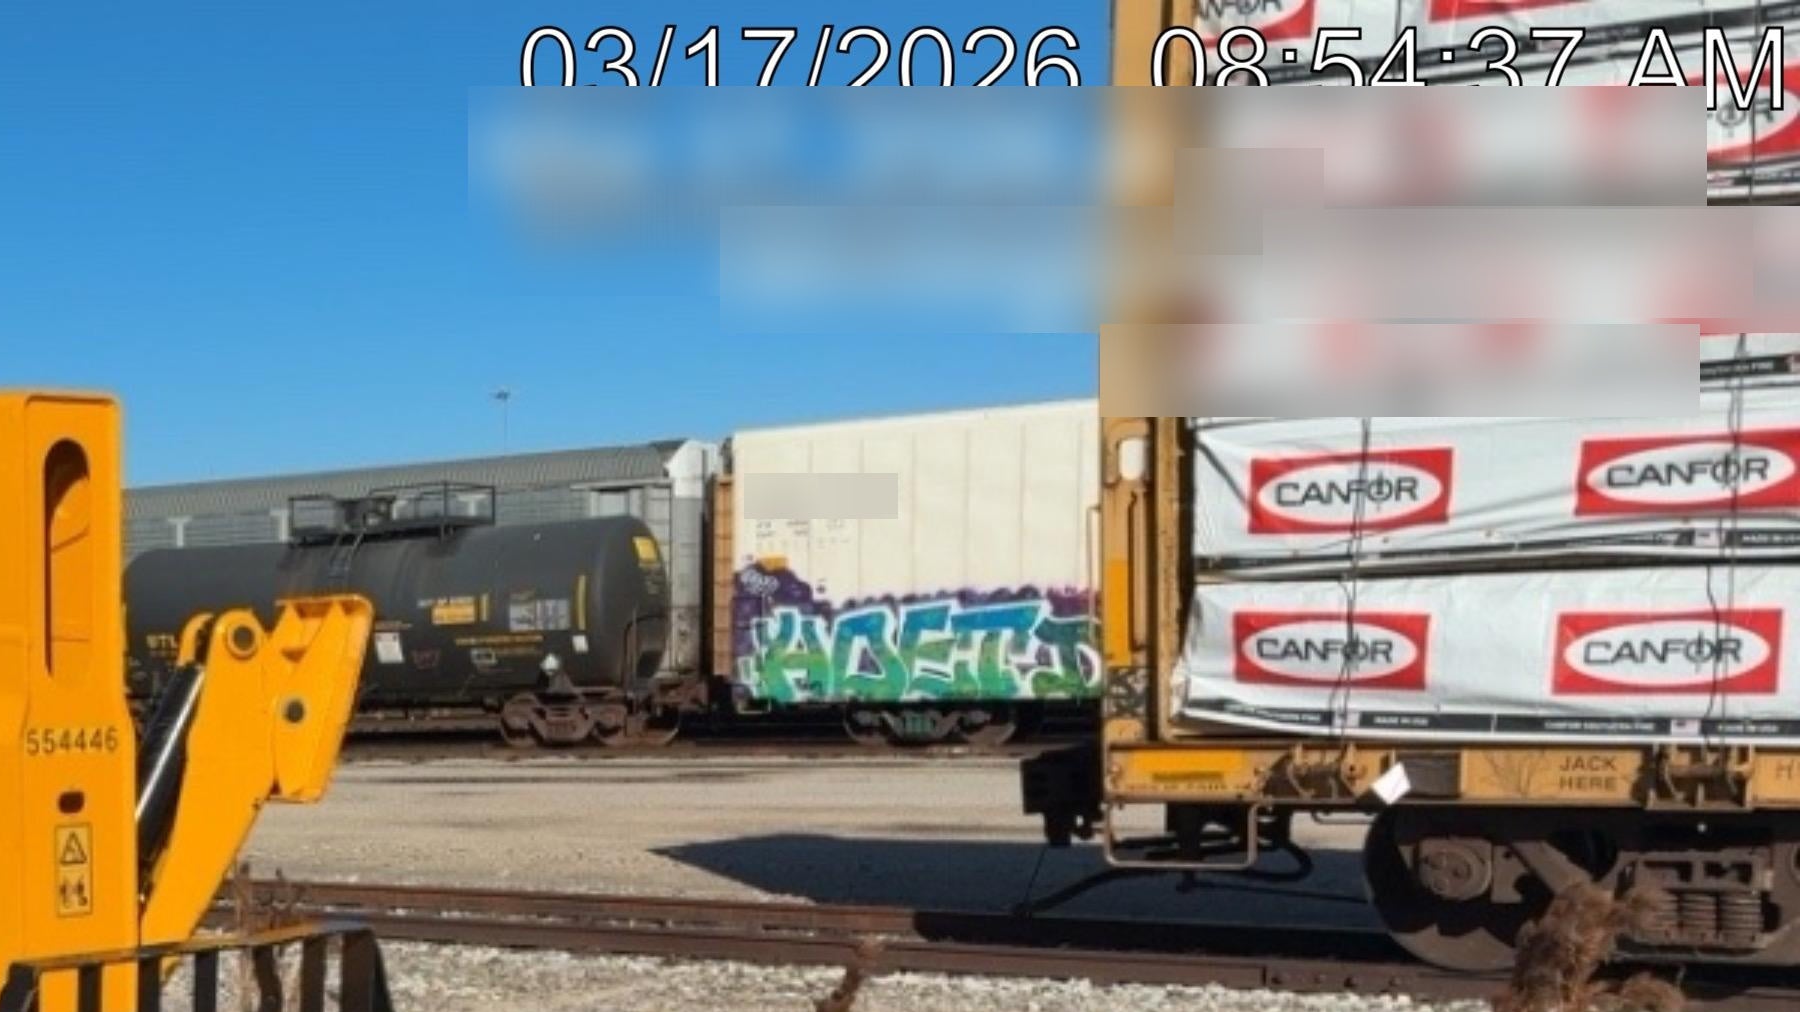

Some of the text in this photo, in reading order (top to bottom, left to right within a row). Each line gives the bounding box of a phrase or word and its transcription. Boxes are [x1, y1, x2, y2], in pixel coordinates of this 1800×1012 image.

[1606, 456, 1770, 488] CANFOR
[1275, 473, 1418, 508] CANFOR
[1256, 636, 1393, 664] CANFOR
[1583, 634, 1743, 667] CANFOR
[26, 725, 120, 756] 554446
[1559, 754, 1618, 772] JACK
[1559, 775, 1617, 792] HERE
